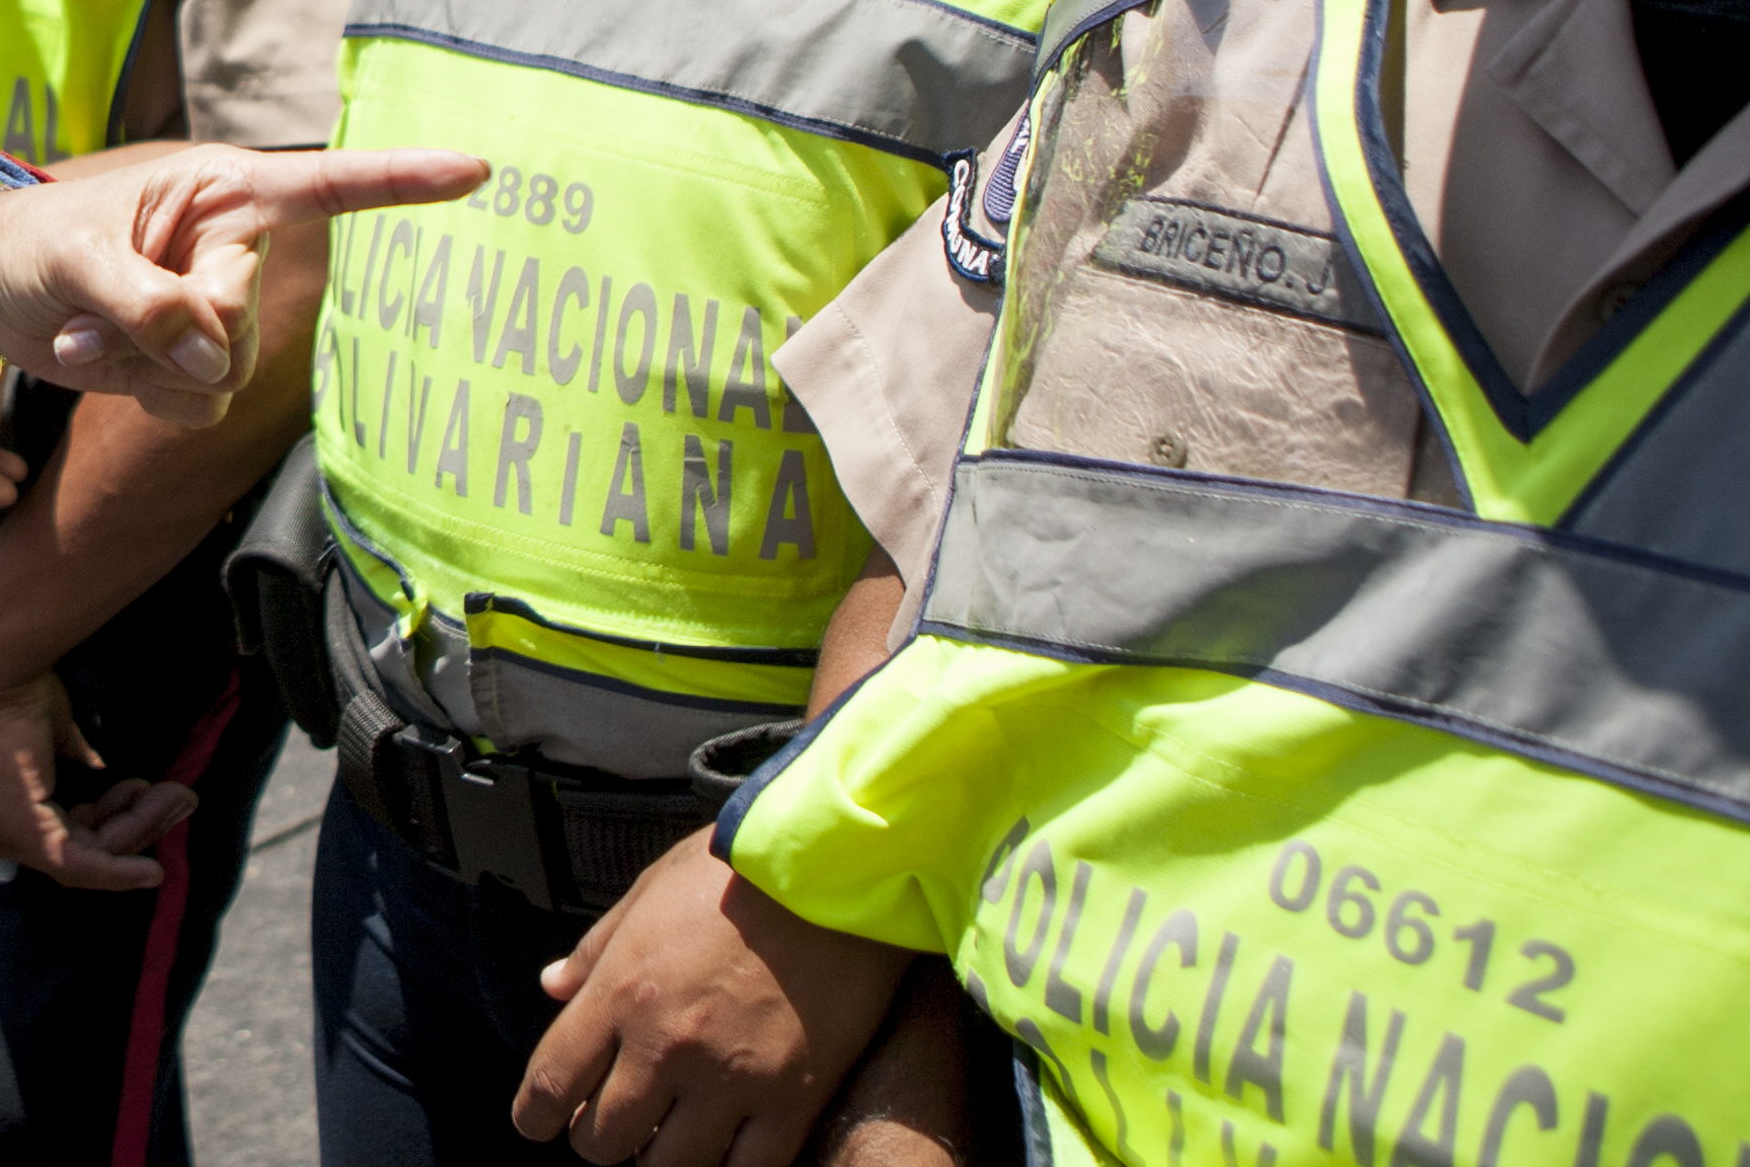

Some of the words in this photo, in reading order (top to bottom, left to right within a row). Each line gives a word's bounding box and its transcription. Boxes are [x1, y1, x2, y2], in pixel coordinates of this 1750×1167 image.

[464, 243, 821, 434] NACIONAL
[312, 311, 817, 561] BLIVARIANA
[1269, 839, 1577, 1025] 06612
